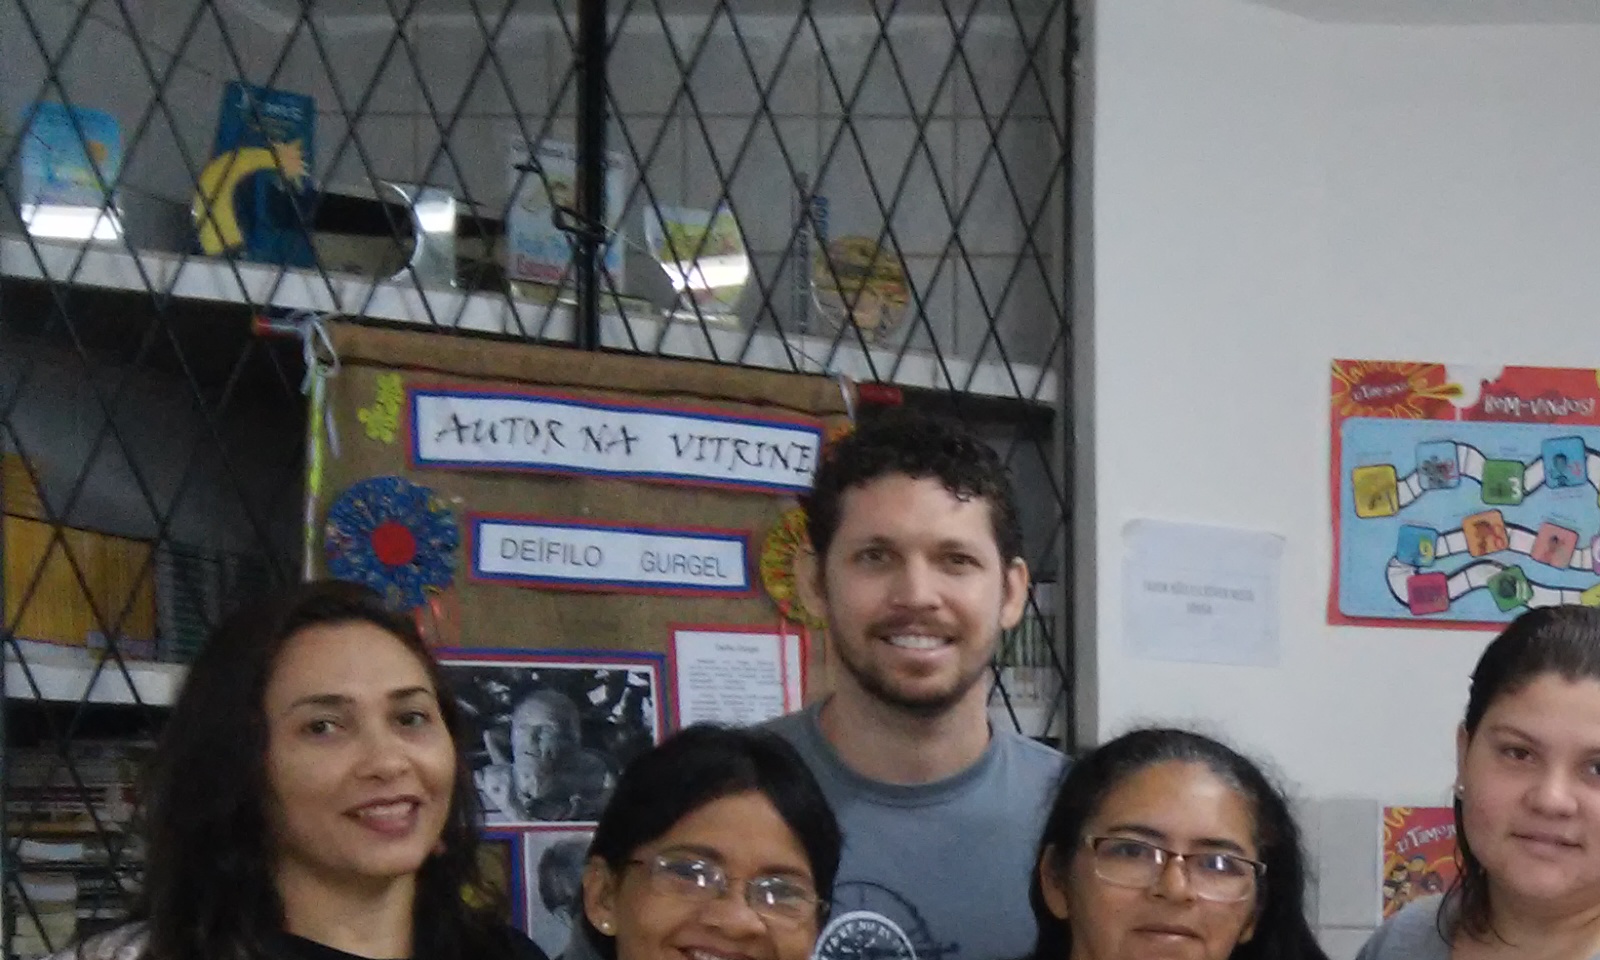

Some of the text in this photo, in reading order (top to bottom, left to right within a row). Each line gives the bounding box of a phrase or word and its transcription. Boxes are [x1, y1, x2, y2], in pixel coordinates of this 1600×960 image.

[435, 412, 813, 473] AUTOR NA VITRINE
[1508, 476, 1521, 498] 3
[1420, 537, 1434, 563] 9
[640, 551, 728, 579] GURGEL
